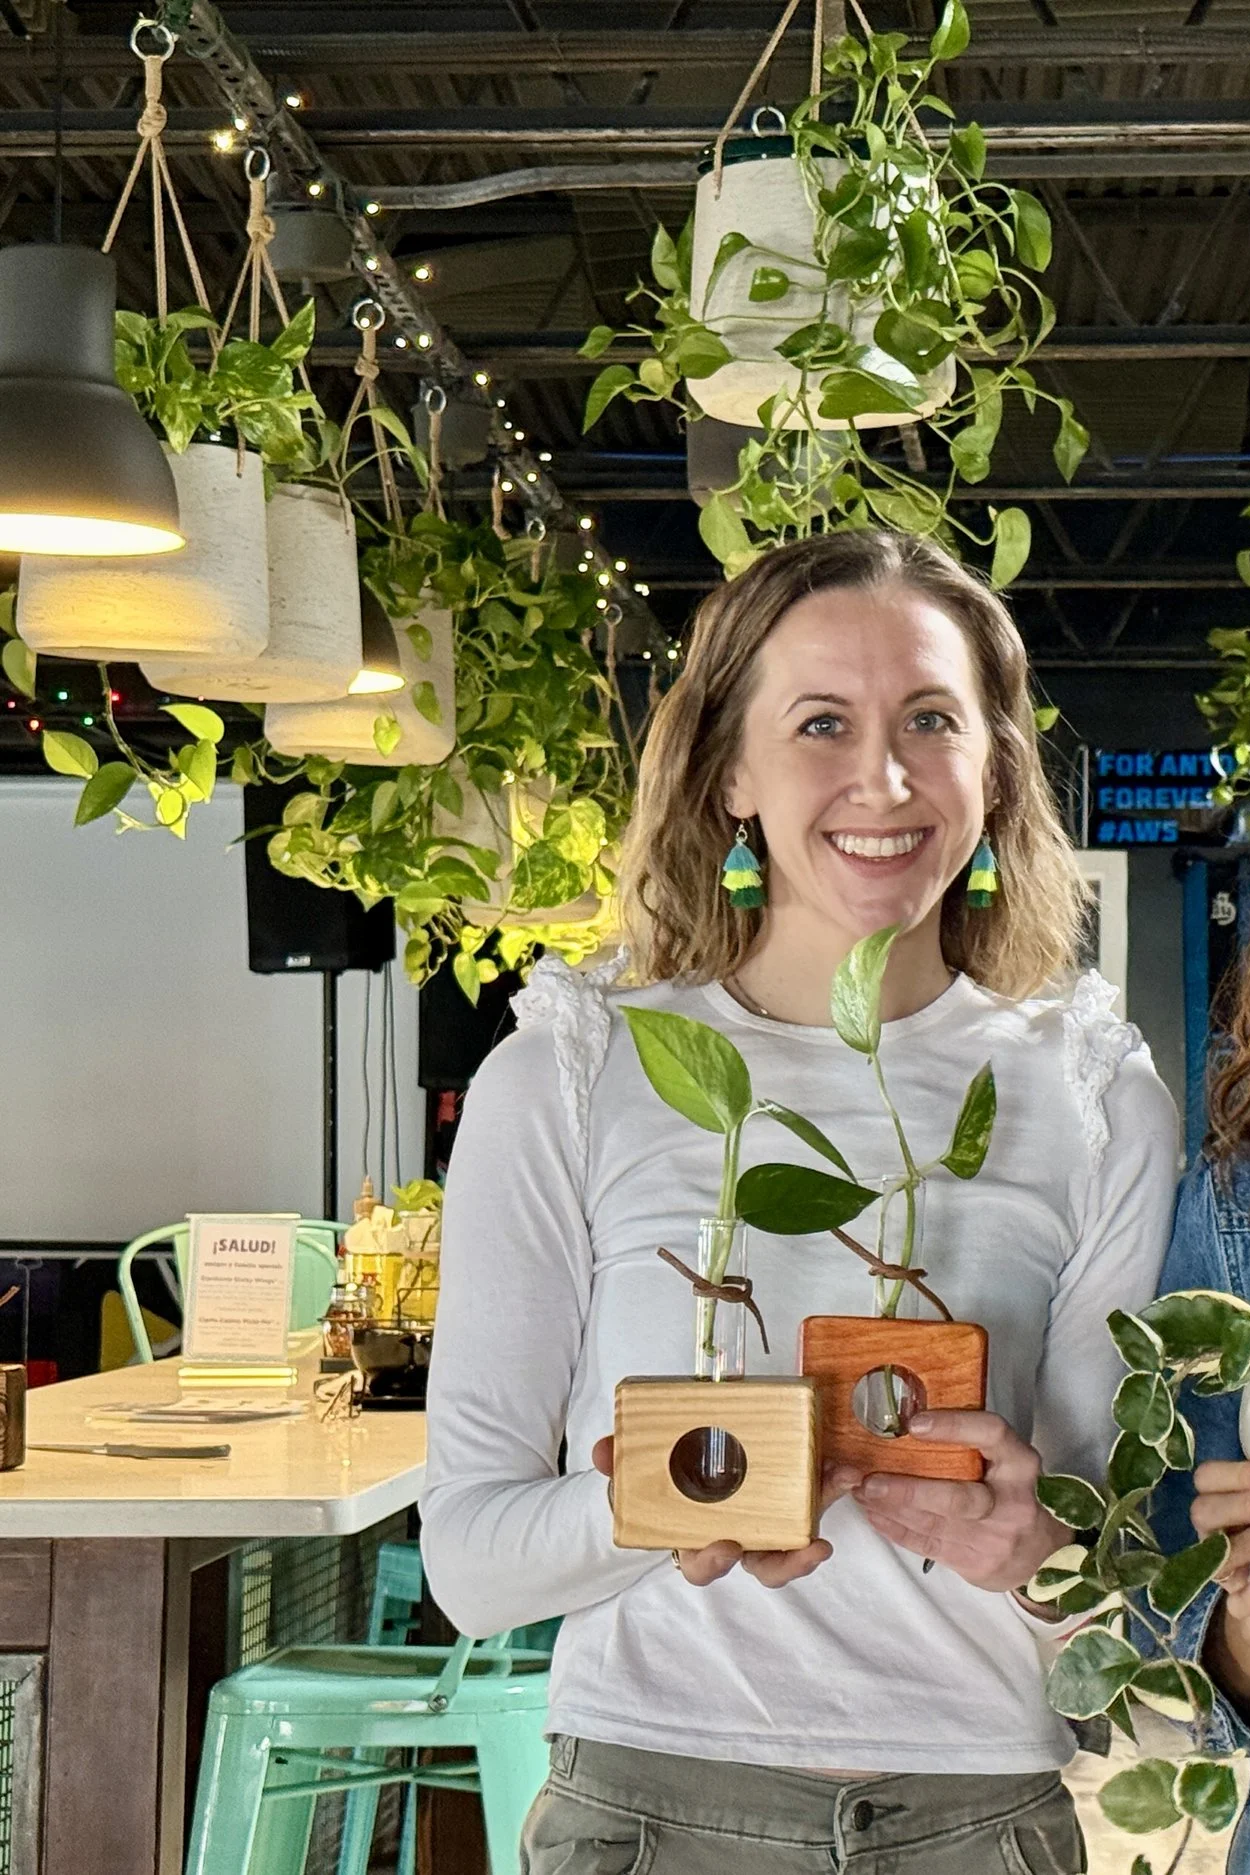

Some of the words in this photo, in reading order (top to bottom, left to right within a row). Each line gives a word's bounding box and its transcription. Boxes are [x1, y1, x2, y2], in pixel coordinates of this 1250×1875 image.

[1098, 753, 1153, 777] FOR
[1098, 786, 1214, 810] FOREVE
[212, 1238, 277, 1255] ¡SALUD!
